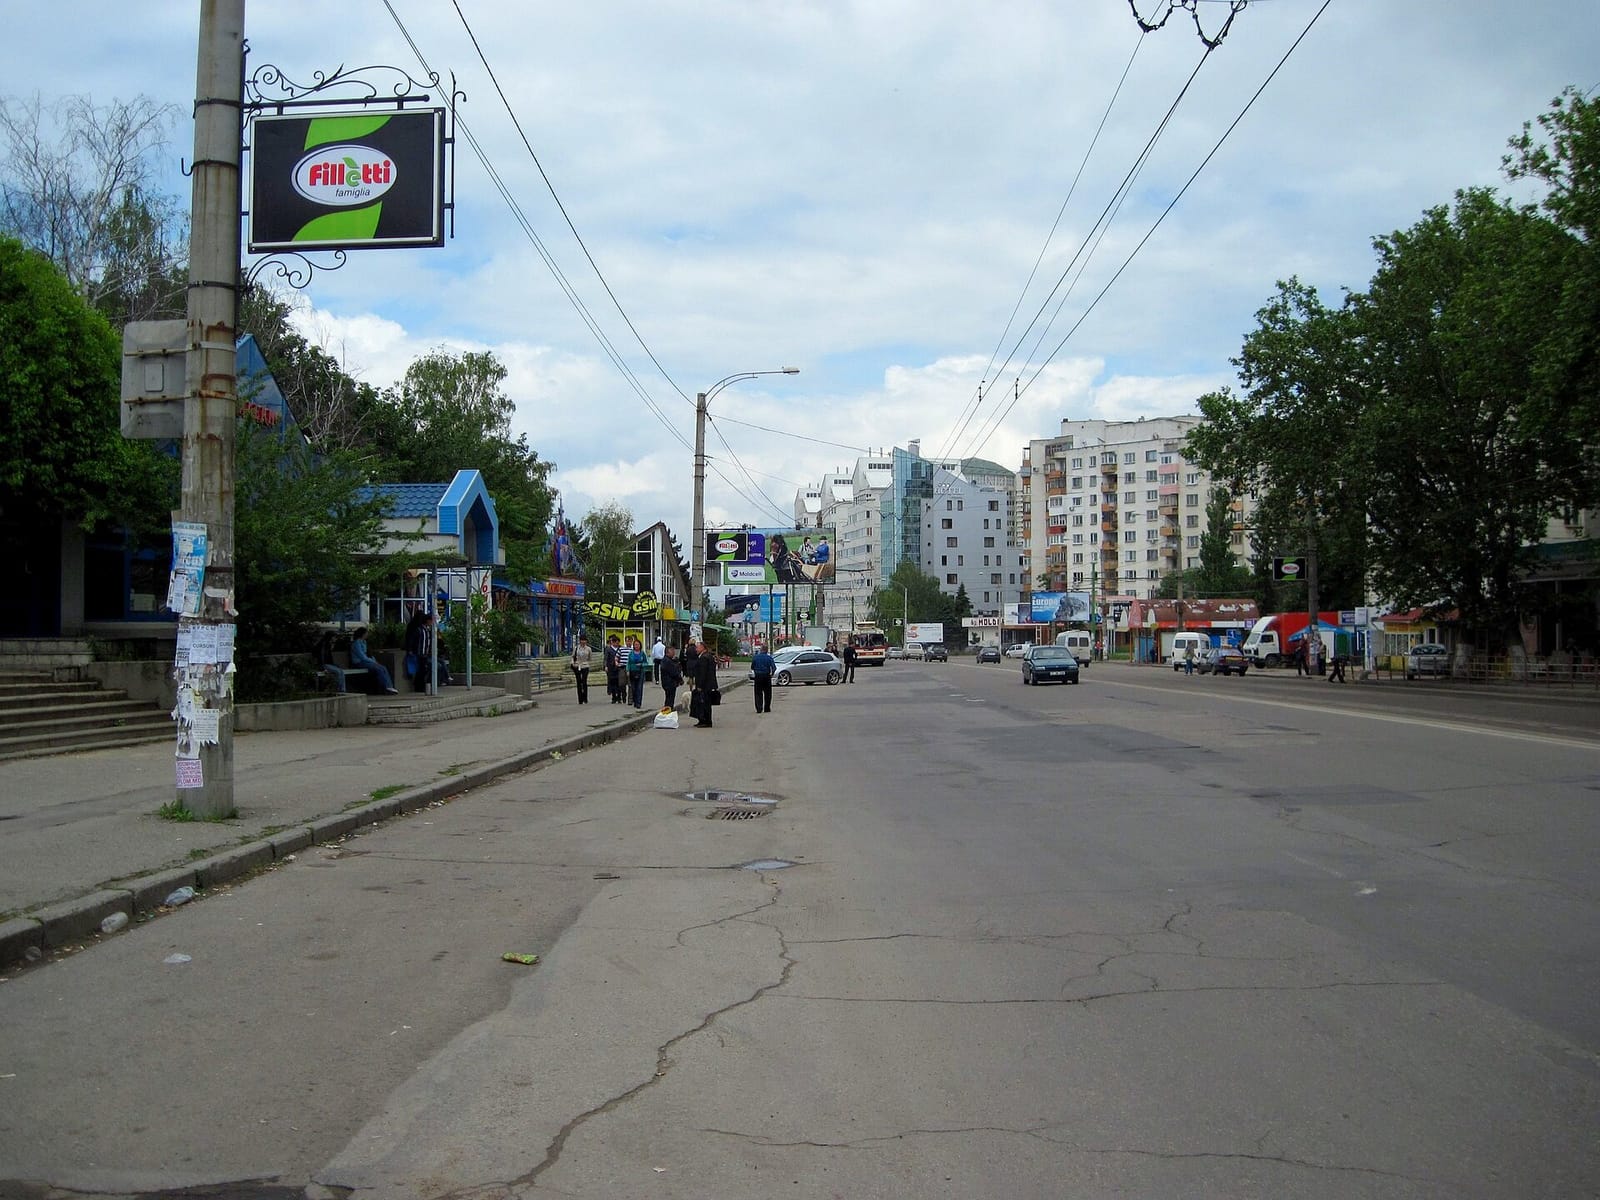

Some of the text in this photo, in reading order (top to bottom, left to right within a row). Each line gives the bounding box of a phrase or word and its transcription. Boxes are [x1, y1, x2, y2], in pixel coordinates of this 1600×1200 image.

[335, 188, 371, 198] famiglia
[588, 601, 631, 621] GSM
[632, 599, 658, 612] GSM
